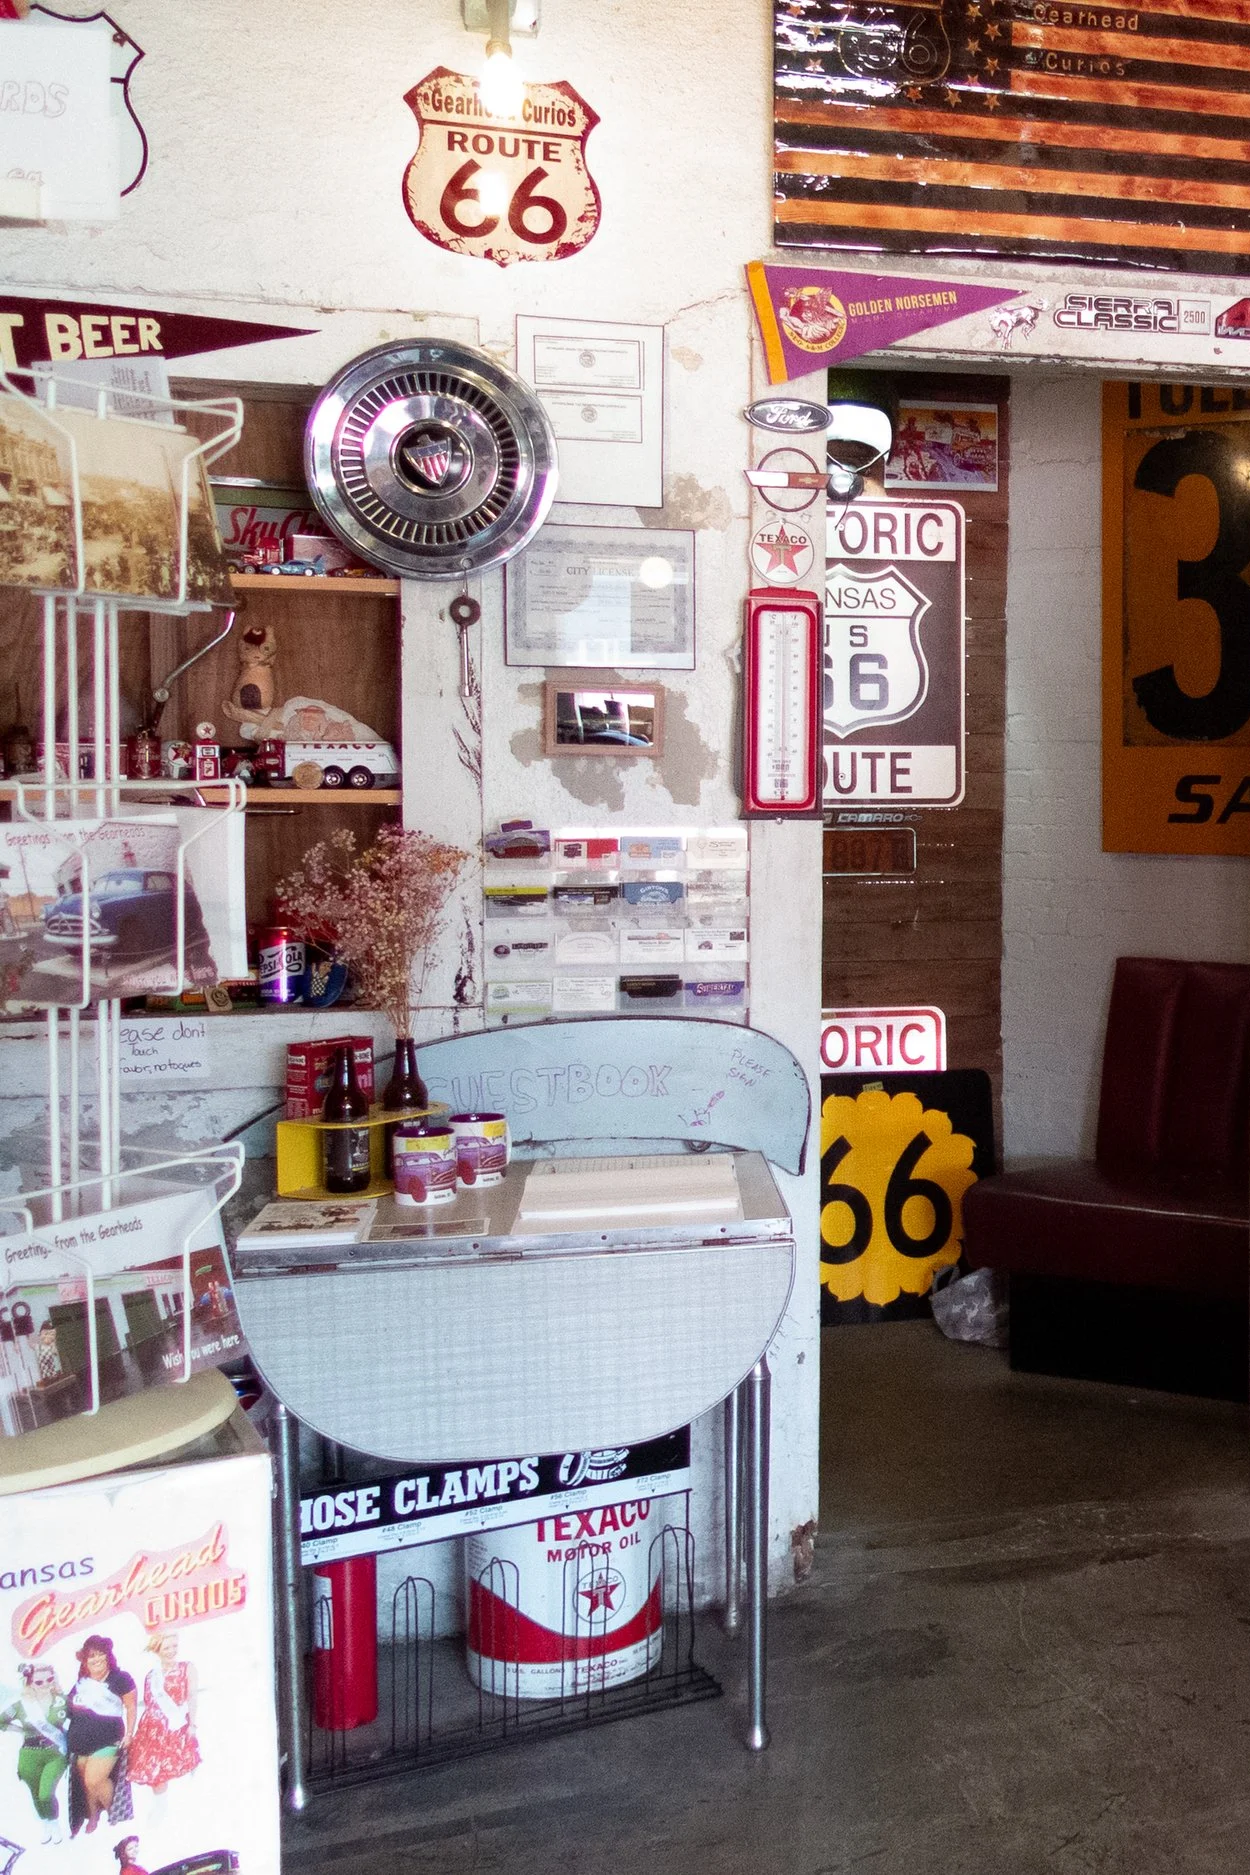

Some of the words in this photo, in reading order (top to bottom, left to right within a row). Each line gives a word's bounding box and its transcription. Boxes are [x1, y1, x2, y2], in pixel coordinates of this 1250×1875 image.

[1033, 4, 1139, 32] Gearhead
[1045, 51, 1126, 77] Curios
[0, 81, 69, 118] RDS
[431, 89, 516, 121] Gearh
[522, 98, 577, 128] Curios
[447, 130, 562, 163] ROUTE
[440, 158, 568, 245] 66
[848, 298, 893, 318] GOLDEN
[895, 290, 958, 312] NORSEMEN
[1066, 294, 1174, 315] SIERRA
[1055, 310, 1179, 332] CLASSIC
[1183, 310, 1206, 325] 2500
[44, 313, 164, 362] BEER
[766, 405, 815, 428] Ford
[223, 507, 279, 549] Sky
[760, 533, 808, 545] TEXACO
[826, 511, 945, 556] ORIC
[566, 566, 590, 576] CITY
[825, 587, 897, 610] NSAS
[823, 653, 889, 711] 6
[823, 751, 913, 794] UTE
[837, 812, 905, 823] CAMARO
[118, 1025, 166, 1044] ease
[128, 1043, 159, 1056] Touch
[732, 1047, 771, 1079] PLEASE
[820, 1130, 953, 1265] 66
[5, 1240, 52, 1266] Greeting
[54, 1233, 78, 1250] from
[79, 1229, 96, 1245] the
[98, 1216, 144, 1240] Gearheads
[161, 1351, 183, 1370] Wish
[199, 1339, 221, 1357] were
[221, 1332, 241, 1352] here
[393, 1456, 540, 1516] CLAMPS
[651, 1471, 672, 1483] Clamp
[565, 1487, 588, 1500] Clamp
[481, 1504, 503, 1515] Clamp
[537, 1499, 652, 1543] TEXACO
[398, 1520, 423, 1532] Clamp
[315, 1536, 339, 1548] Clamp
[547, 1540, 613, 1563] MOTOR
[620, 1533, 642, 1550] OIL
[0, 1556, 95, 1590] ansas
[19, 1523, 226, 1656] Gearhead
[143, 1572, 247, 1628] CURIOS
[573, 1658, 618, 1675] TEXACO
